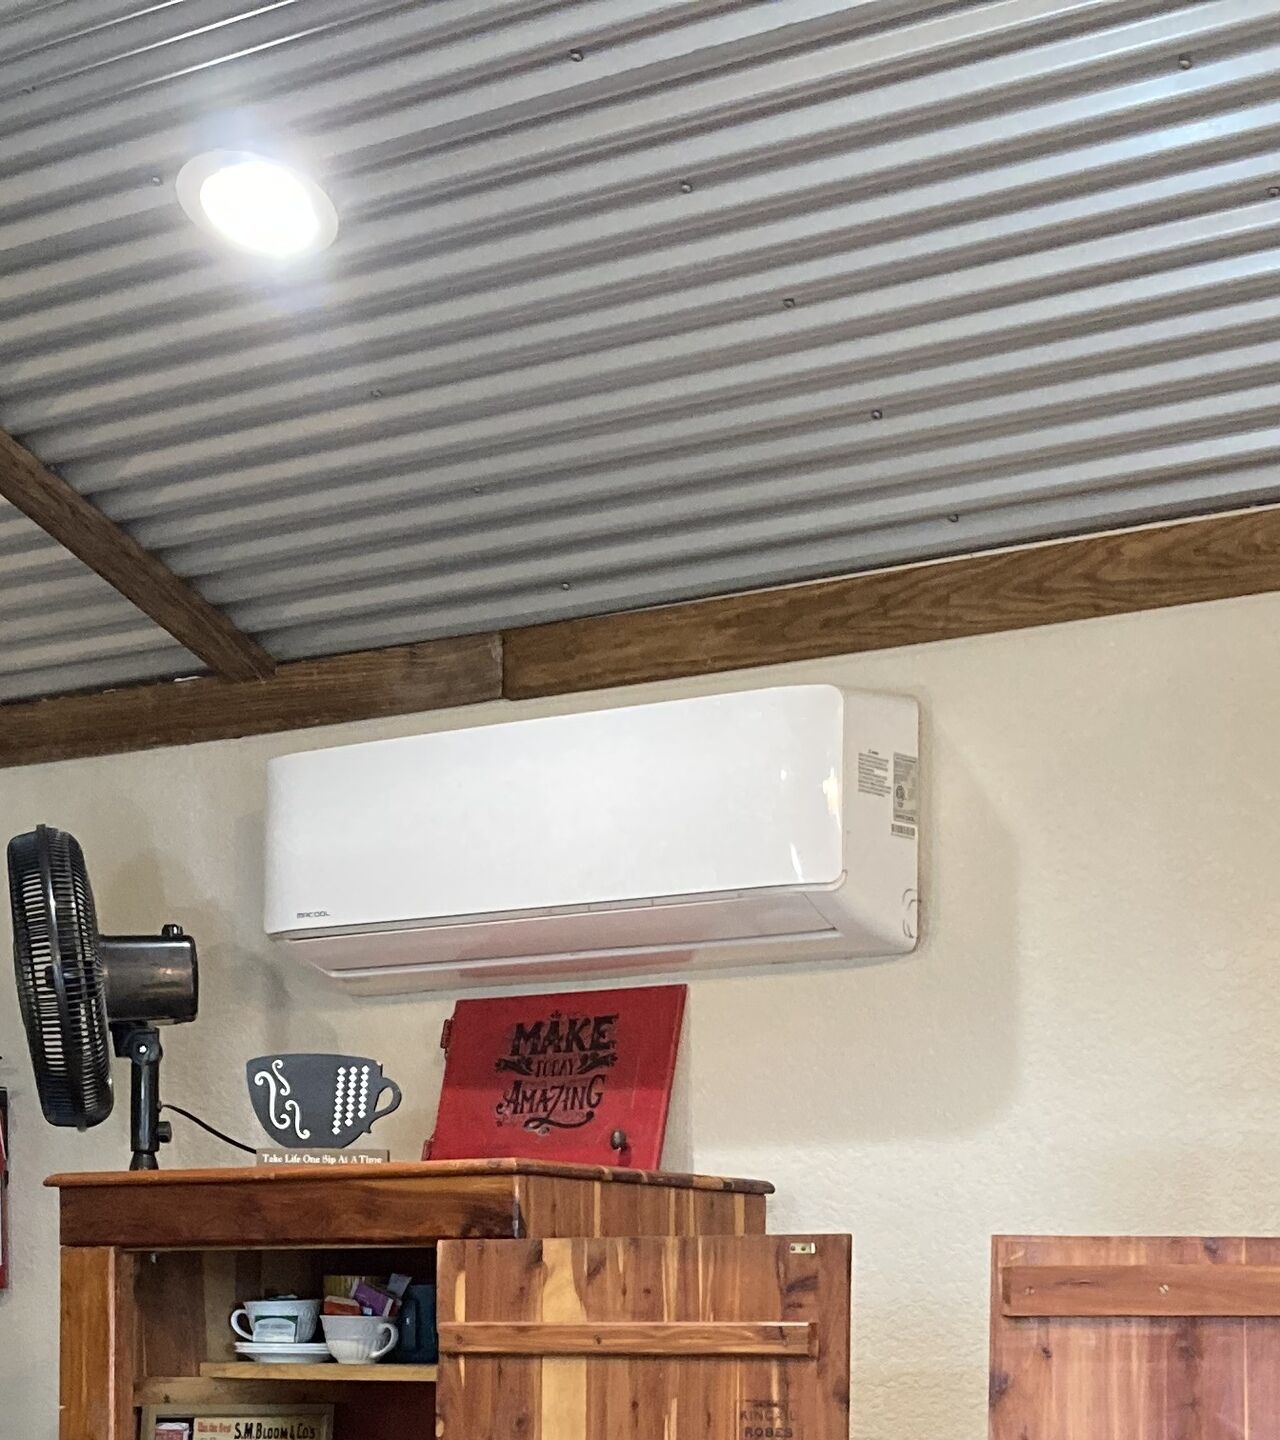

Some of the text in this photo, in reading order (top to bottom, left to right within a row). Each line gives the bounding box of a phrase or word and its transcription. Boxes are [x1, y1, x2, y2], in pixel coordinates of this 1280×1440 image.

[509, 1012, 619, 1056] MAKE
[496, 1074, 606, 1129] AMAZING
[262, 1153, 283, 1163] Take
[285, 1153, 301, 1164] Life
[302, 1154, 321, 1164] One
[359, 1154, 383, 1164] Time
